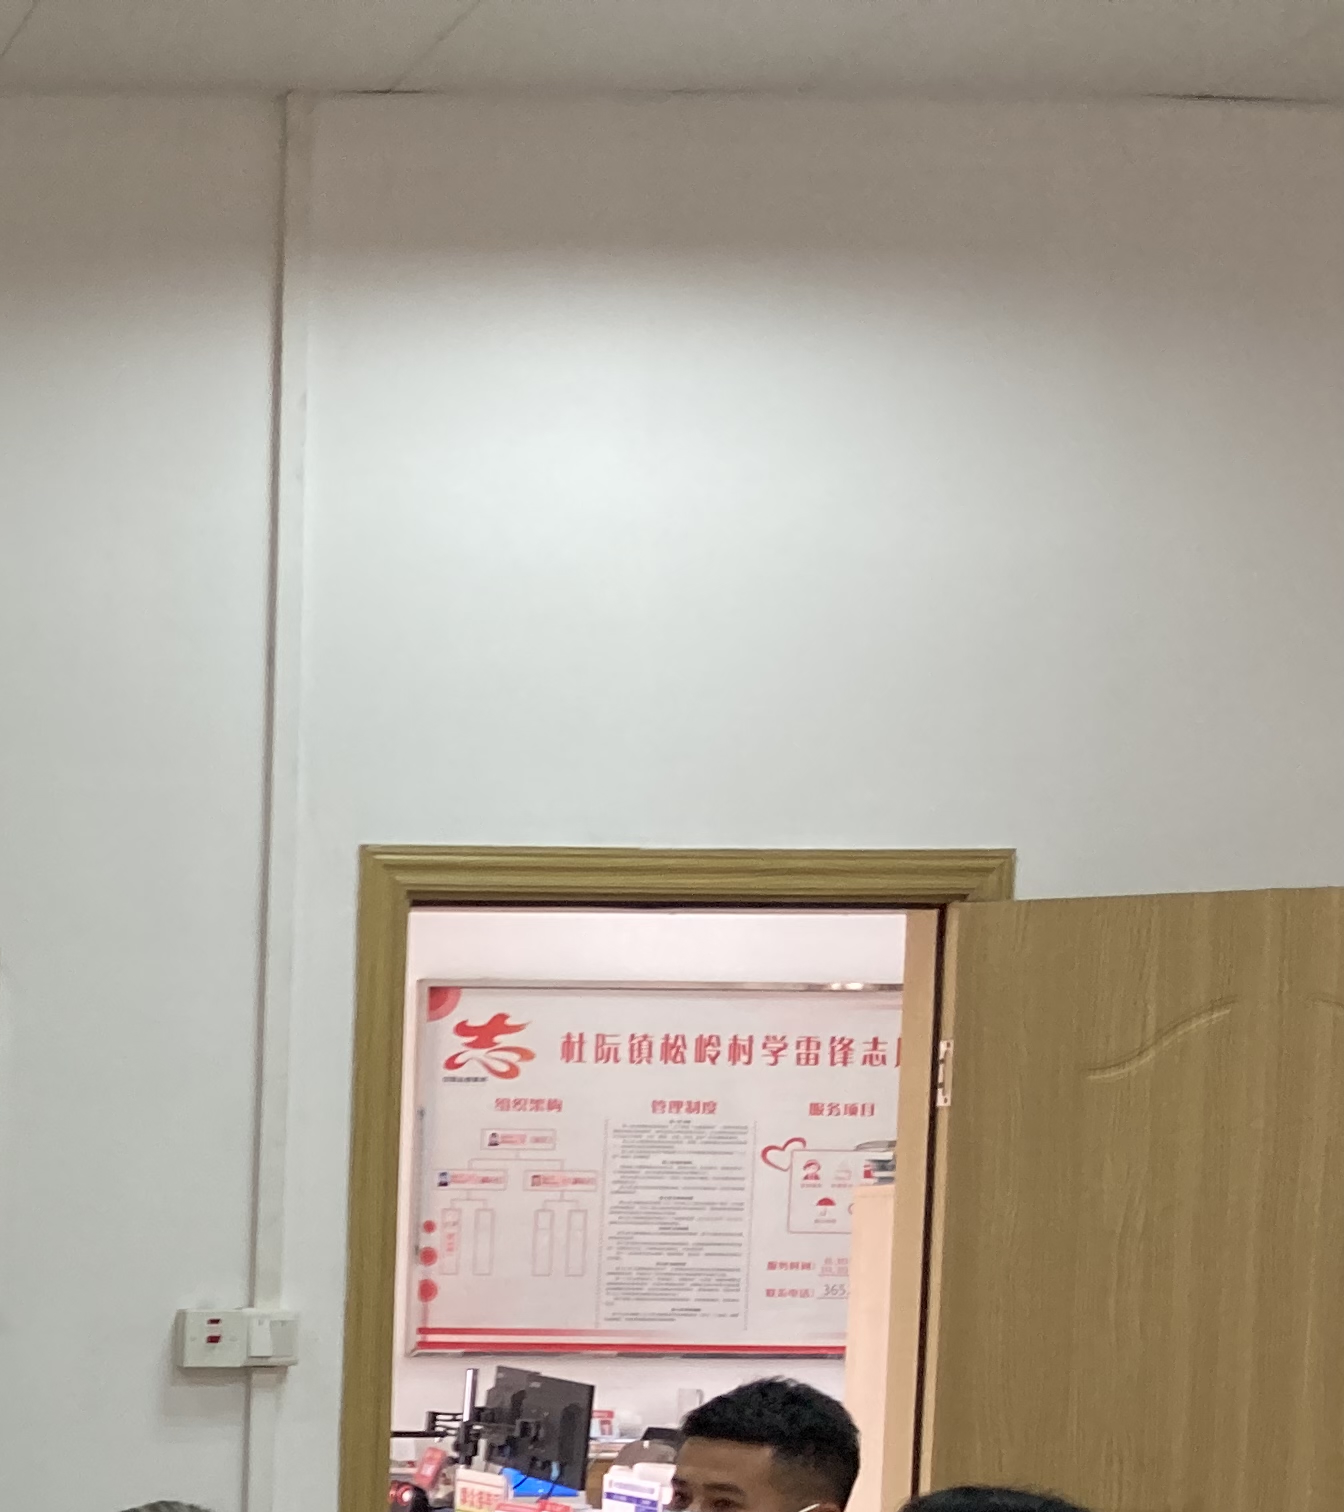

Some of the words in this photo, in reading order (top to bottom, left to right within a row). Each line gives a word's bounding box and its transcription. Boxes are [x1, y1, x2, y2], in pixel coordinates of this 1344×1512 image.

[560, 1031, 902, 1068] 杜阮镇松岭村学雷锋志
